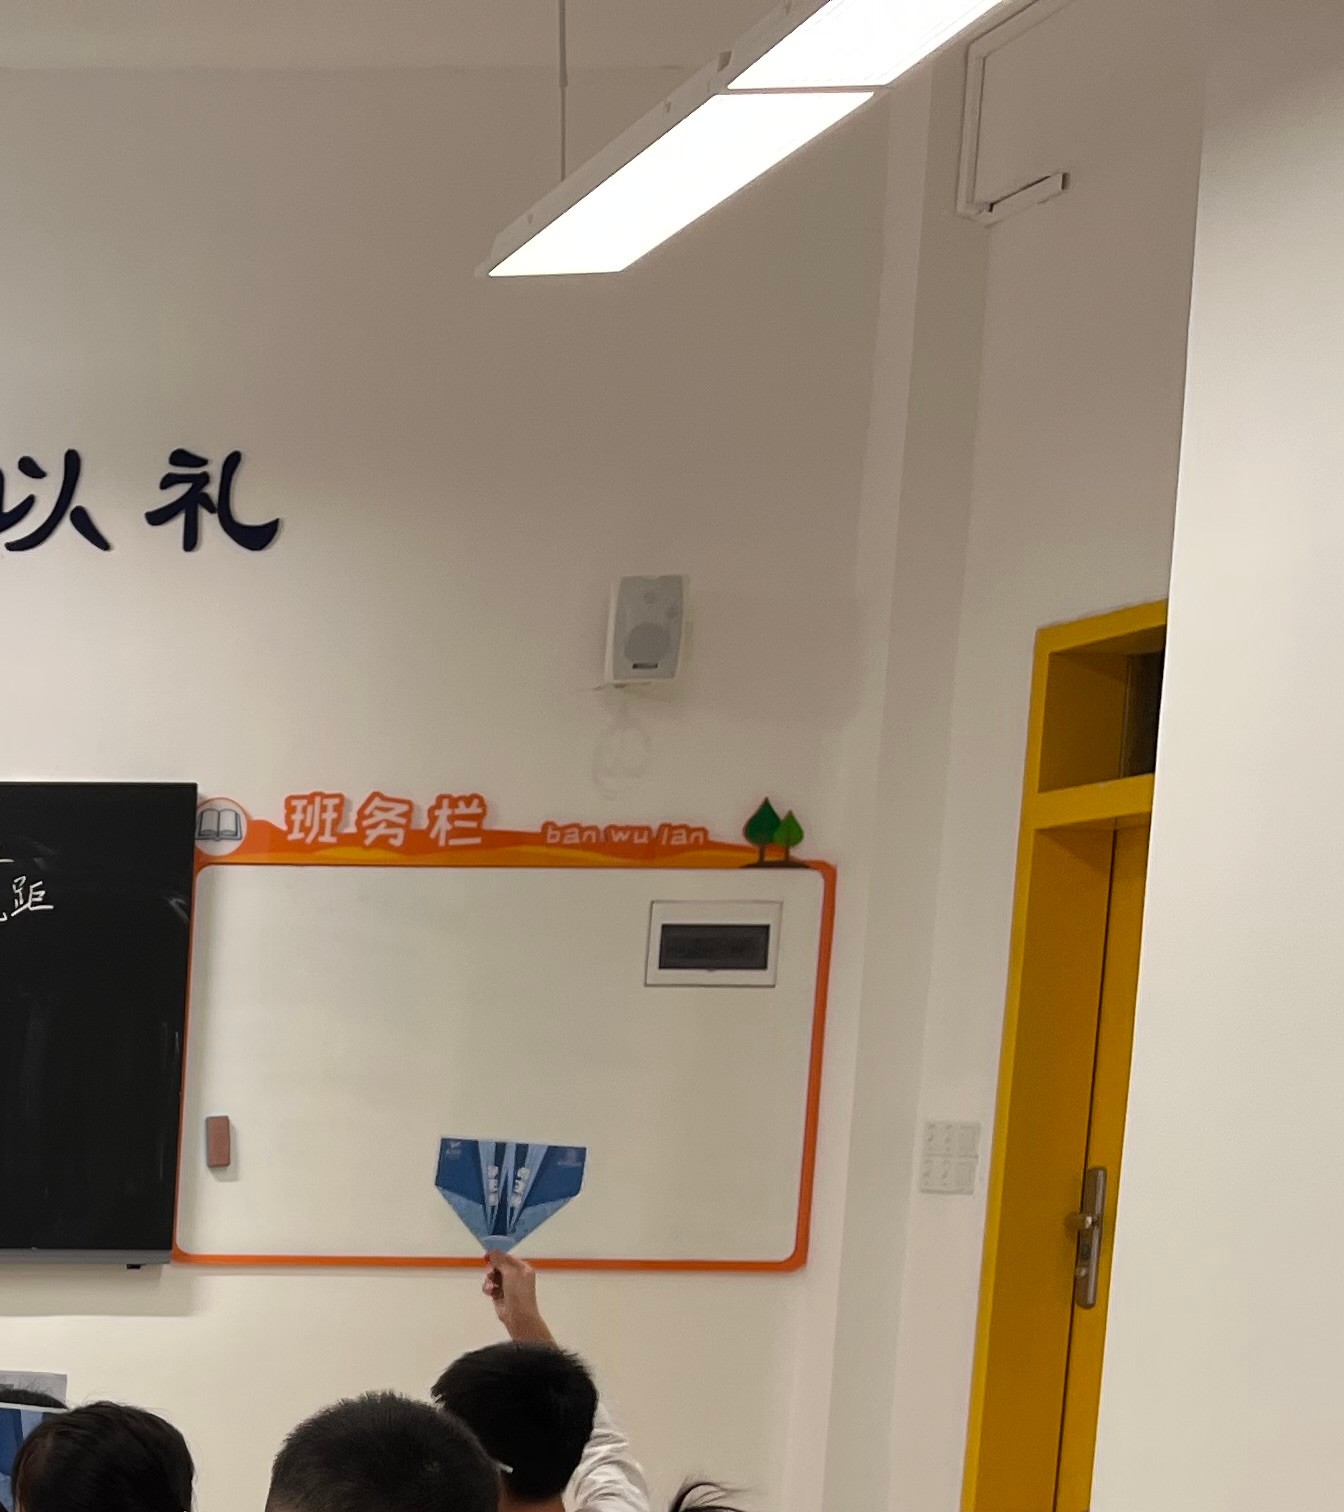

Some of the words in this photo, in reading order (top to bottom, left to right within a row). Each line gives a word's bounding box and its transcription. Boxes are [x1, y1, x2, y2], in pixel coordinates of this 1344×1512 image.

[287, 796, 483, 847] 班务栏
[546, 827, 596, 844] ban
[611, 829, 648, 844] wu
[661, 827, 705, 845] lan
